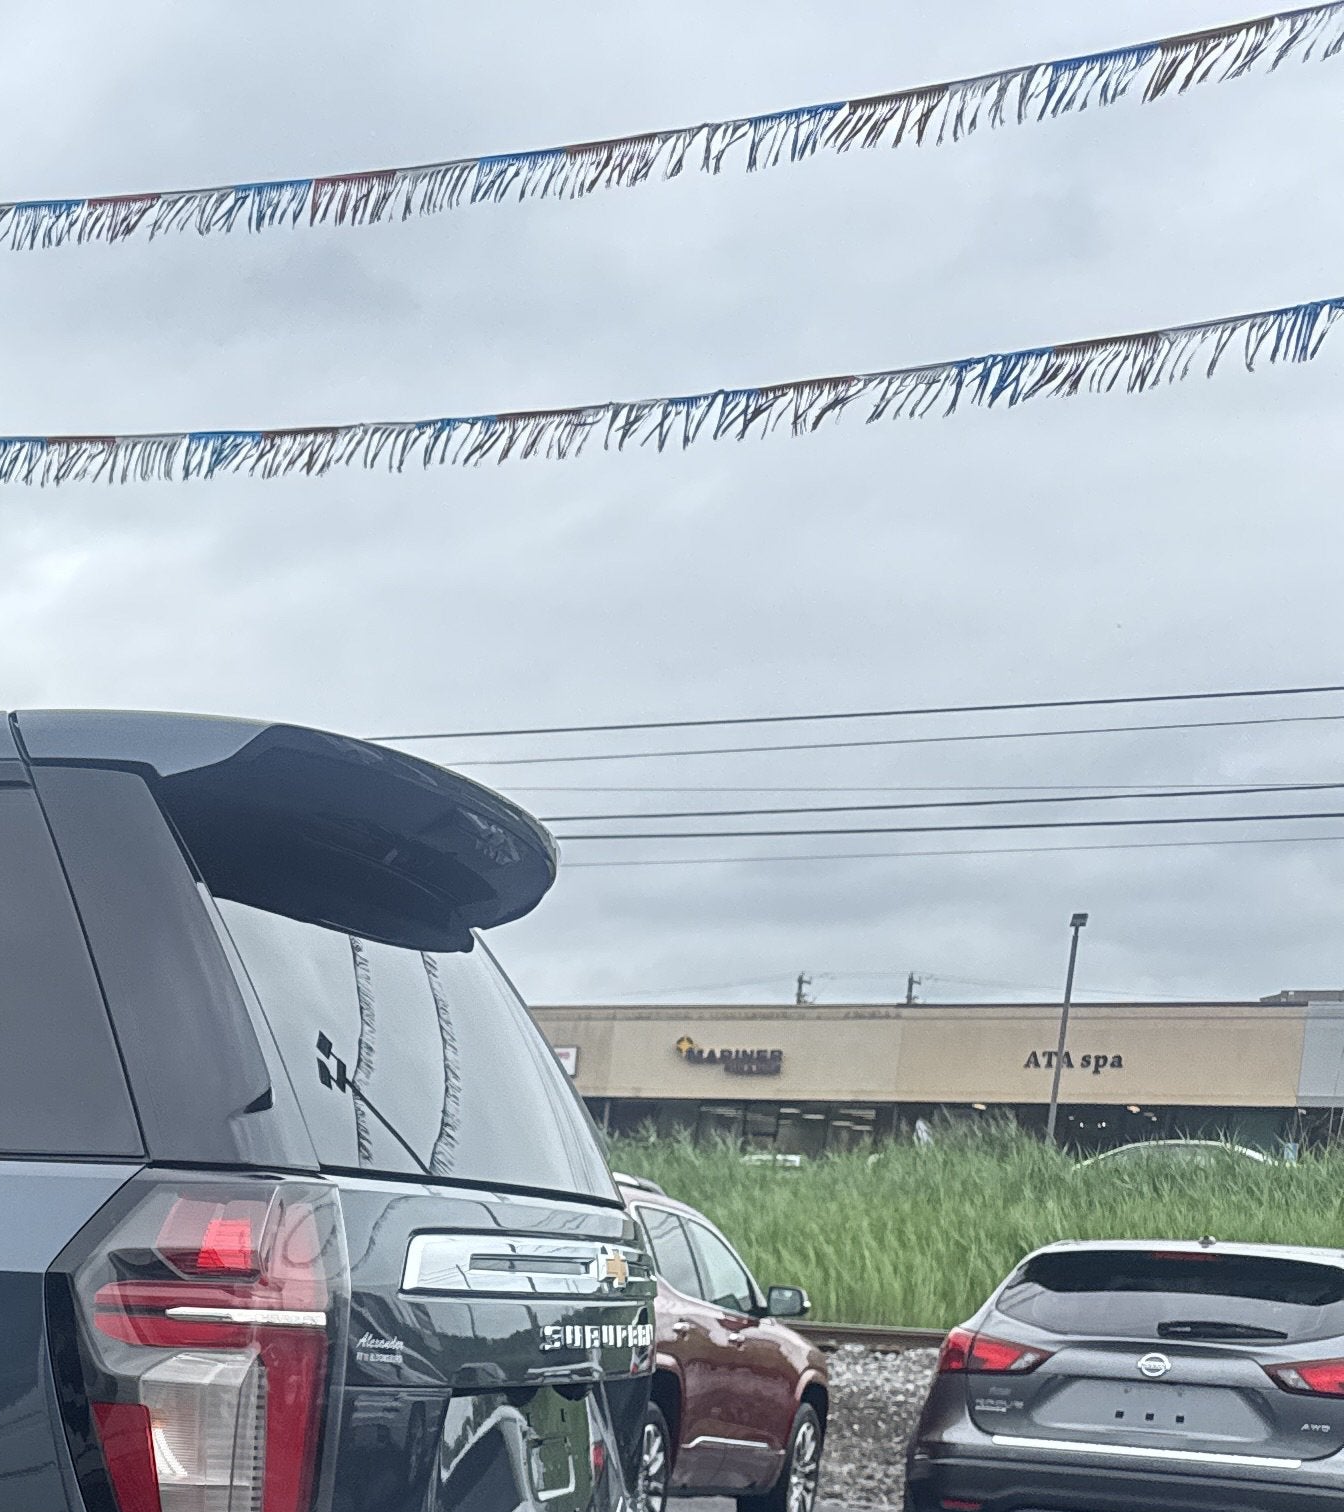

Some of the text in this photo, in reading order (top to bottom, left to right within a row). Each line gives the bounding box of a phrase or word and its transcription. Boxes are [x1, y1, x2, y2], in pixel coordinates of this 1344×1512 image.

[1023, 1050, 1123, 1074] ATA spa
[1300, 1423, 1331, 1432] AWD
